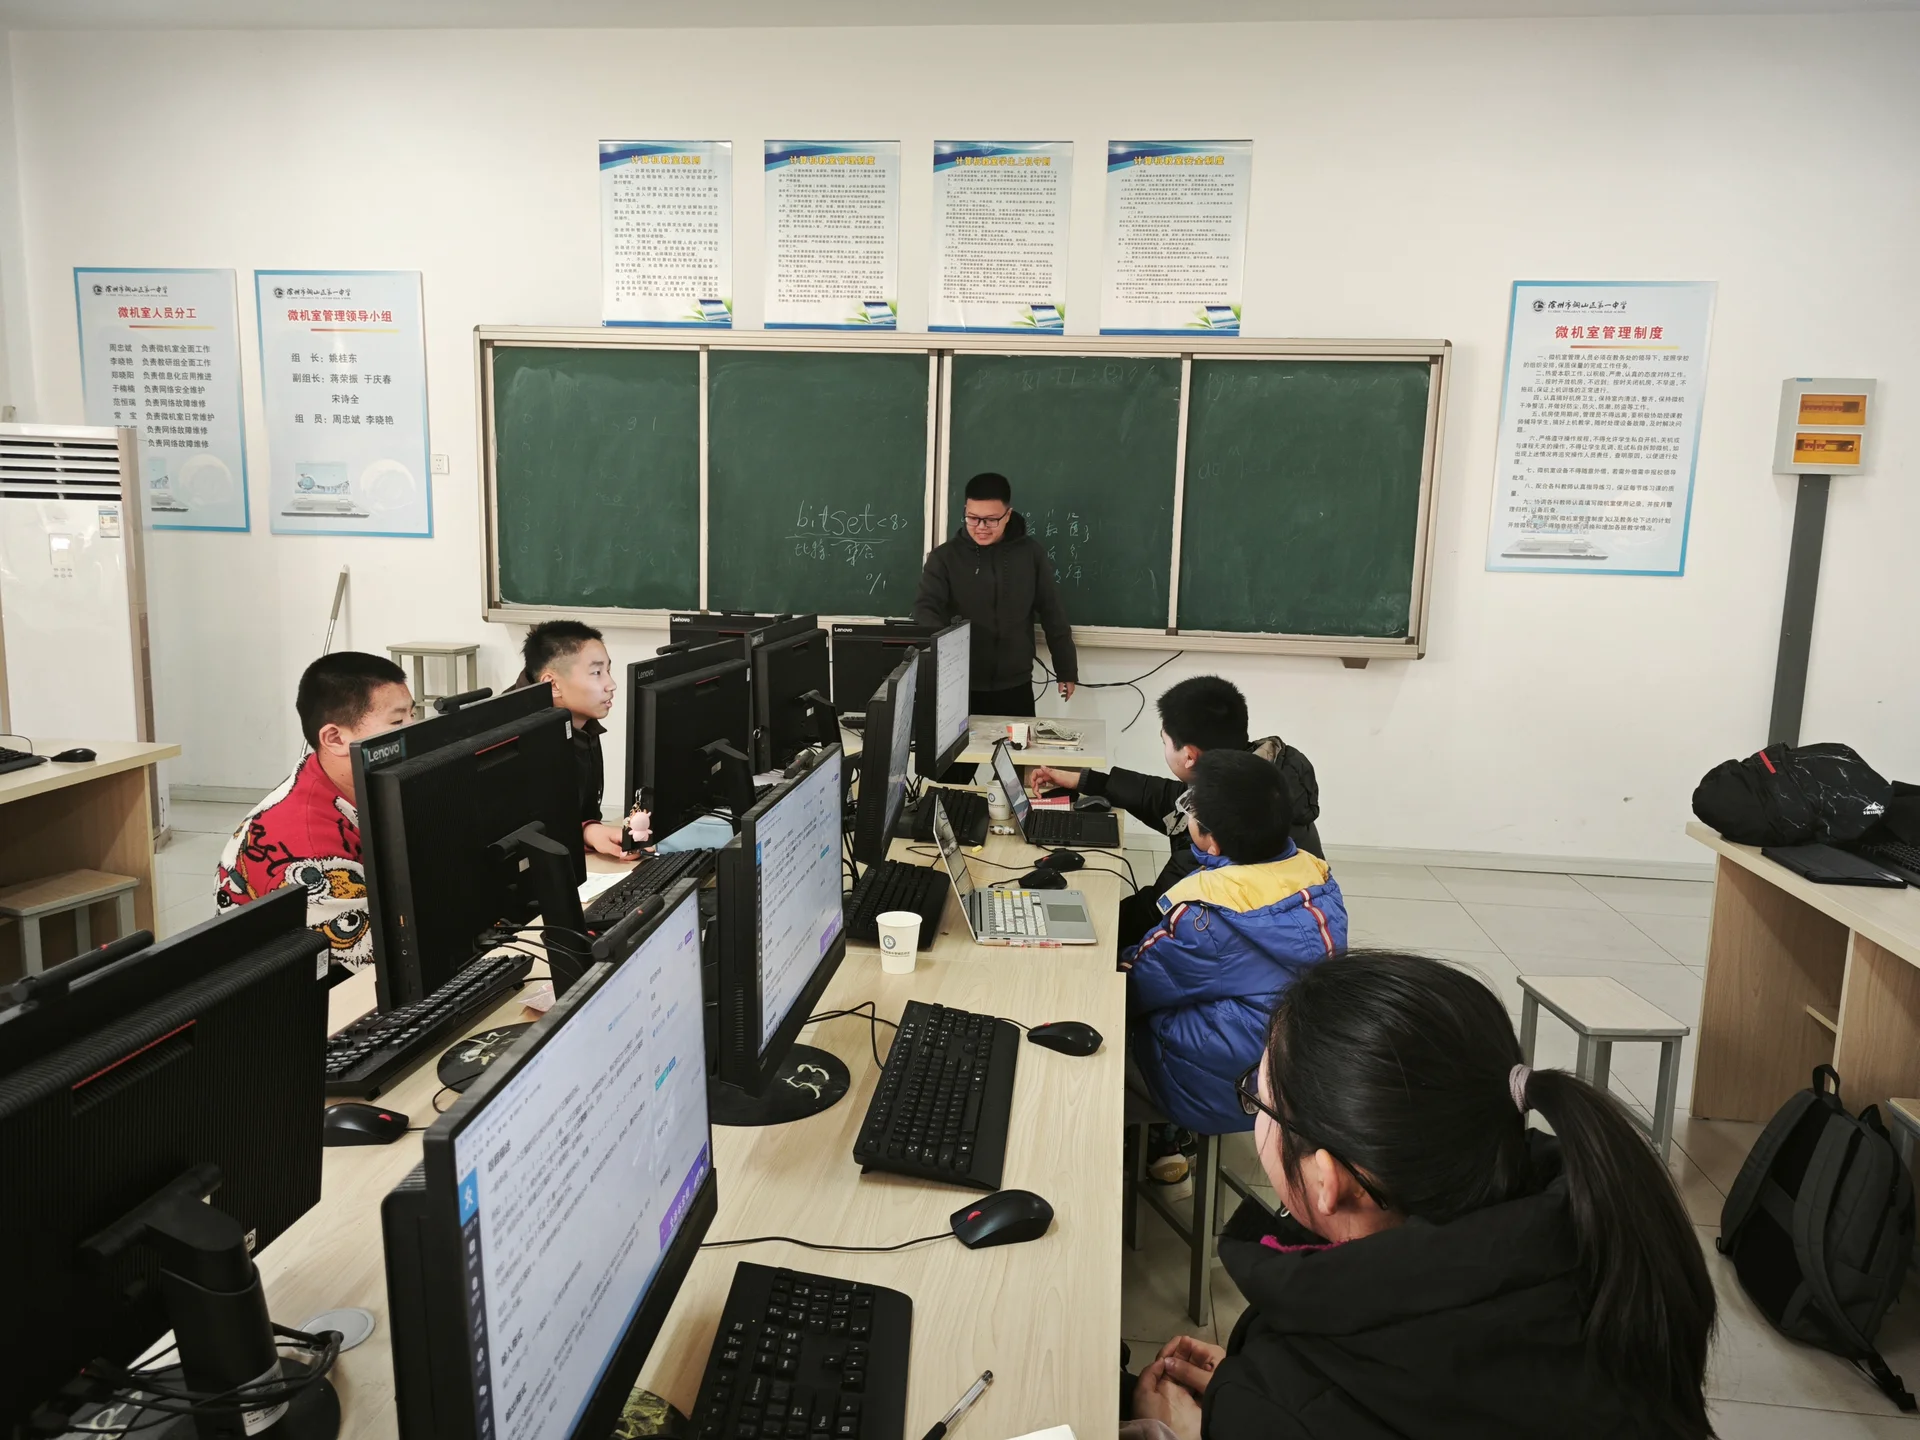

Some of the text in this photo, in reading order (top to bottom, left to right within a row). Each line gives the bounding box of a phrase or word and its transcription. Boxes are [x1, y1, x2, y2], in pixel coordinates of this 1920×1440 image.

[118, 306, 197, 319] 微机室人员分工
[288, 309, 393, 322] 微机室管理领导小组
[1555, 326, 1664, 340] 微机室管理制度
[141, 345, 210, 353] 负责微机室全面工作
[142, 358, 211, 367] 负责教研组全面工作
[143, 371, 212, 381] 负责信息化应用推进
[364, 374, 392, 385] 于庆春
[144, 385, 206, 394] 负责网络安全维护
[145, 399, 206, 408] 负责网络故障维修
[331, 394, 360, 405] 宋诗全
[146, 412, 215, 421] 负责微机室日常维护
[366, 414, 394, 426] 李晓艳
[147, 425, 208, 435] 负责网络故障维修
[148, 439, 209, 448] 负责网络故障维修
[637, 669, 655, 680] Lenovo
[367, 743, 400, 763] Lenovo
